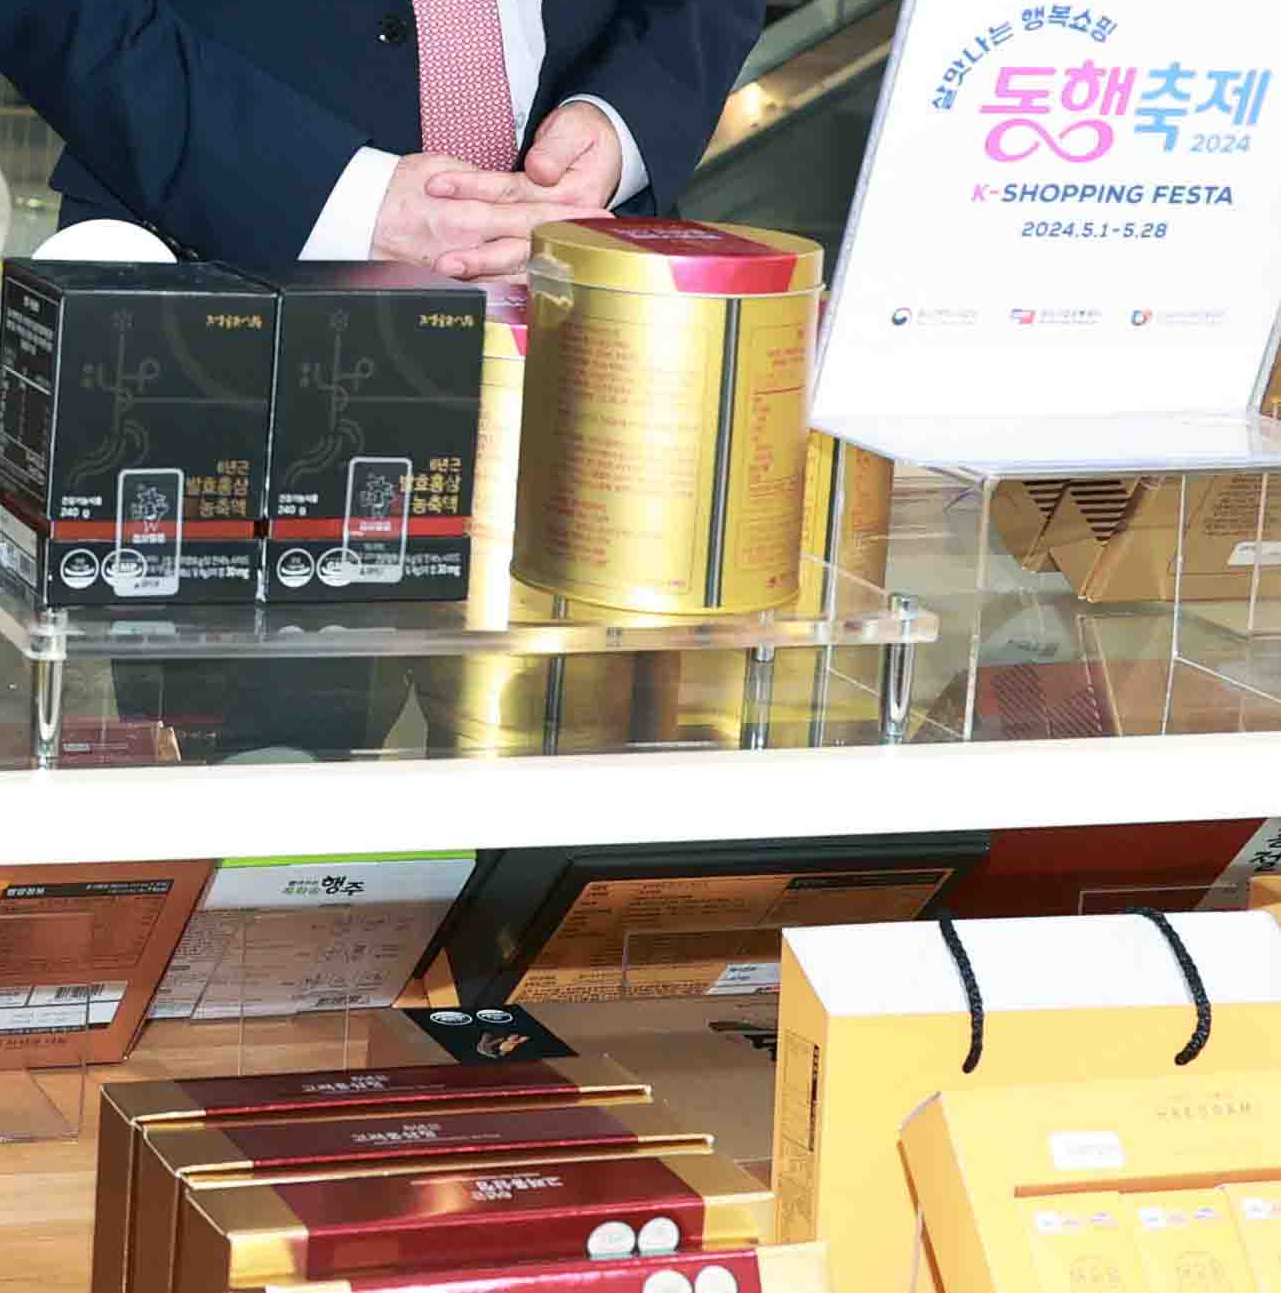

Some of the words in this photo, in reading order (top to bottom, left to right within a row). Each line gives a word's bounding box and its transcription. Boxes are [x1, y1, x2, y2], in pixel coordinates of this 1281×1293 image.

[931, 20, 1015, 111] 살맛나는
[1020, 3, 1119, 44] 행복쇼핑
[979, 58, 1274, 163] 동행축제
[1189, 133, 1252, 155] 2024
[970, 182, 1144, 205] K-SHOPPING
[1151, 184, 1235, 206] FESTA
[1020, 220, 1169, 239] 2024.5.1-5.28
